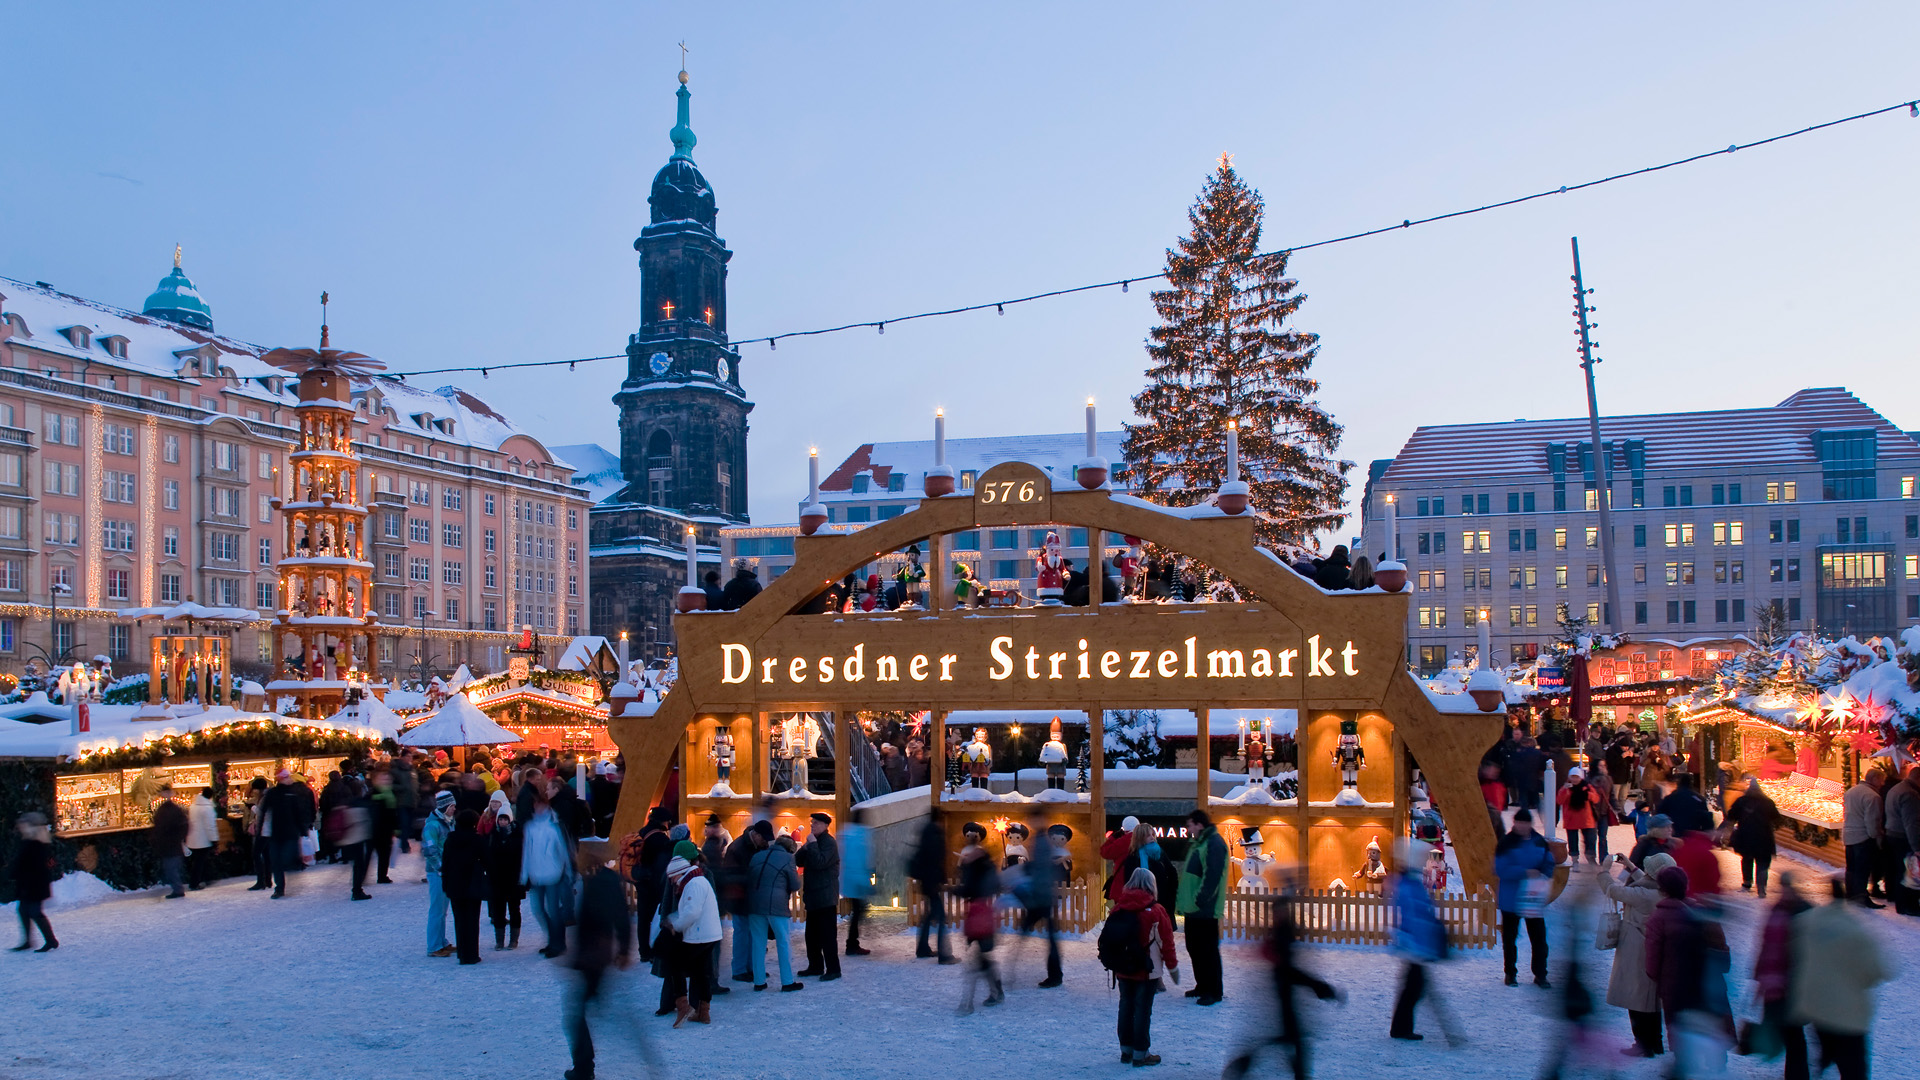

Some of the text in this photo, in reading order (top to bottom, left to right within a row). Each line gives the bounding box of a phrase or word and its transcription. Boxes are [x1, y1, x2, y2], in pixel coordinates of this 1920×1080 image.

[981, 480, 1043, 504] 576.
[721, 635, 1359, 684] Dresdner Striezelmarkt
[1153, 826, 1195, 838] MAR
